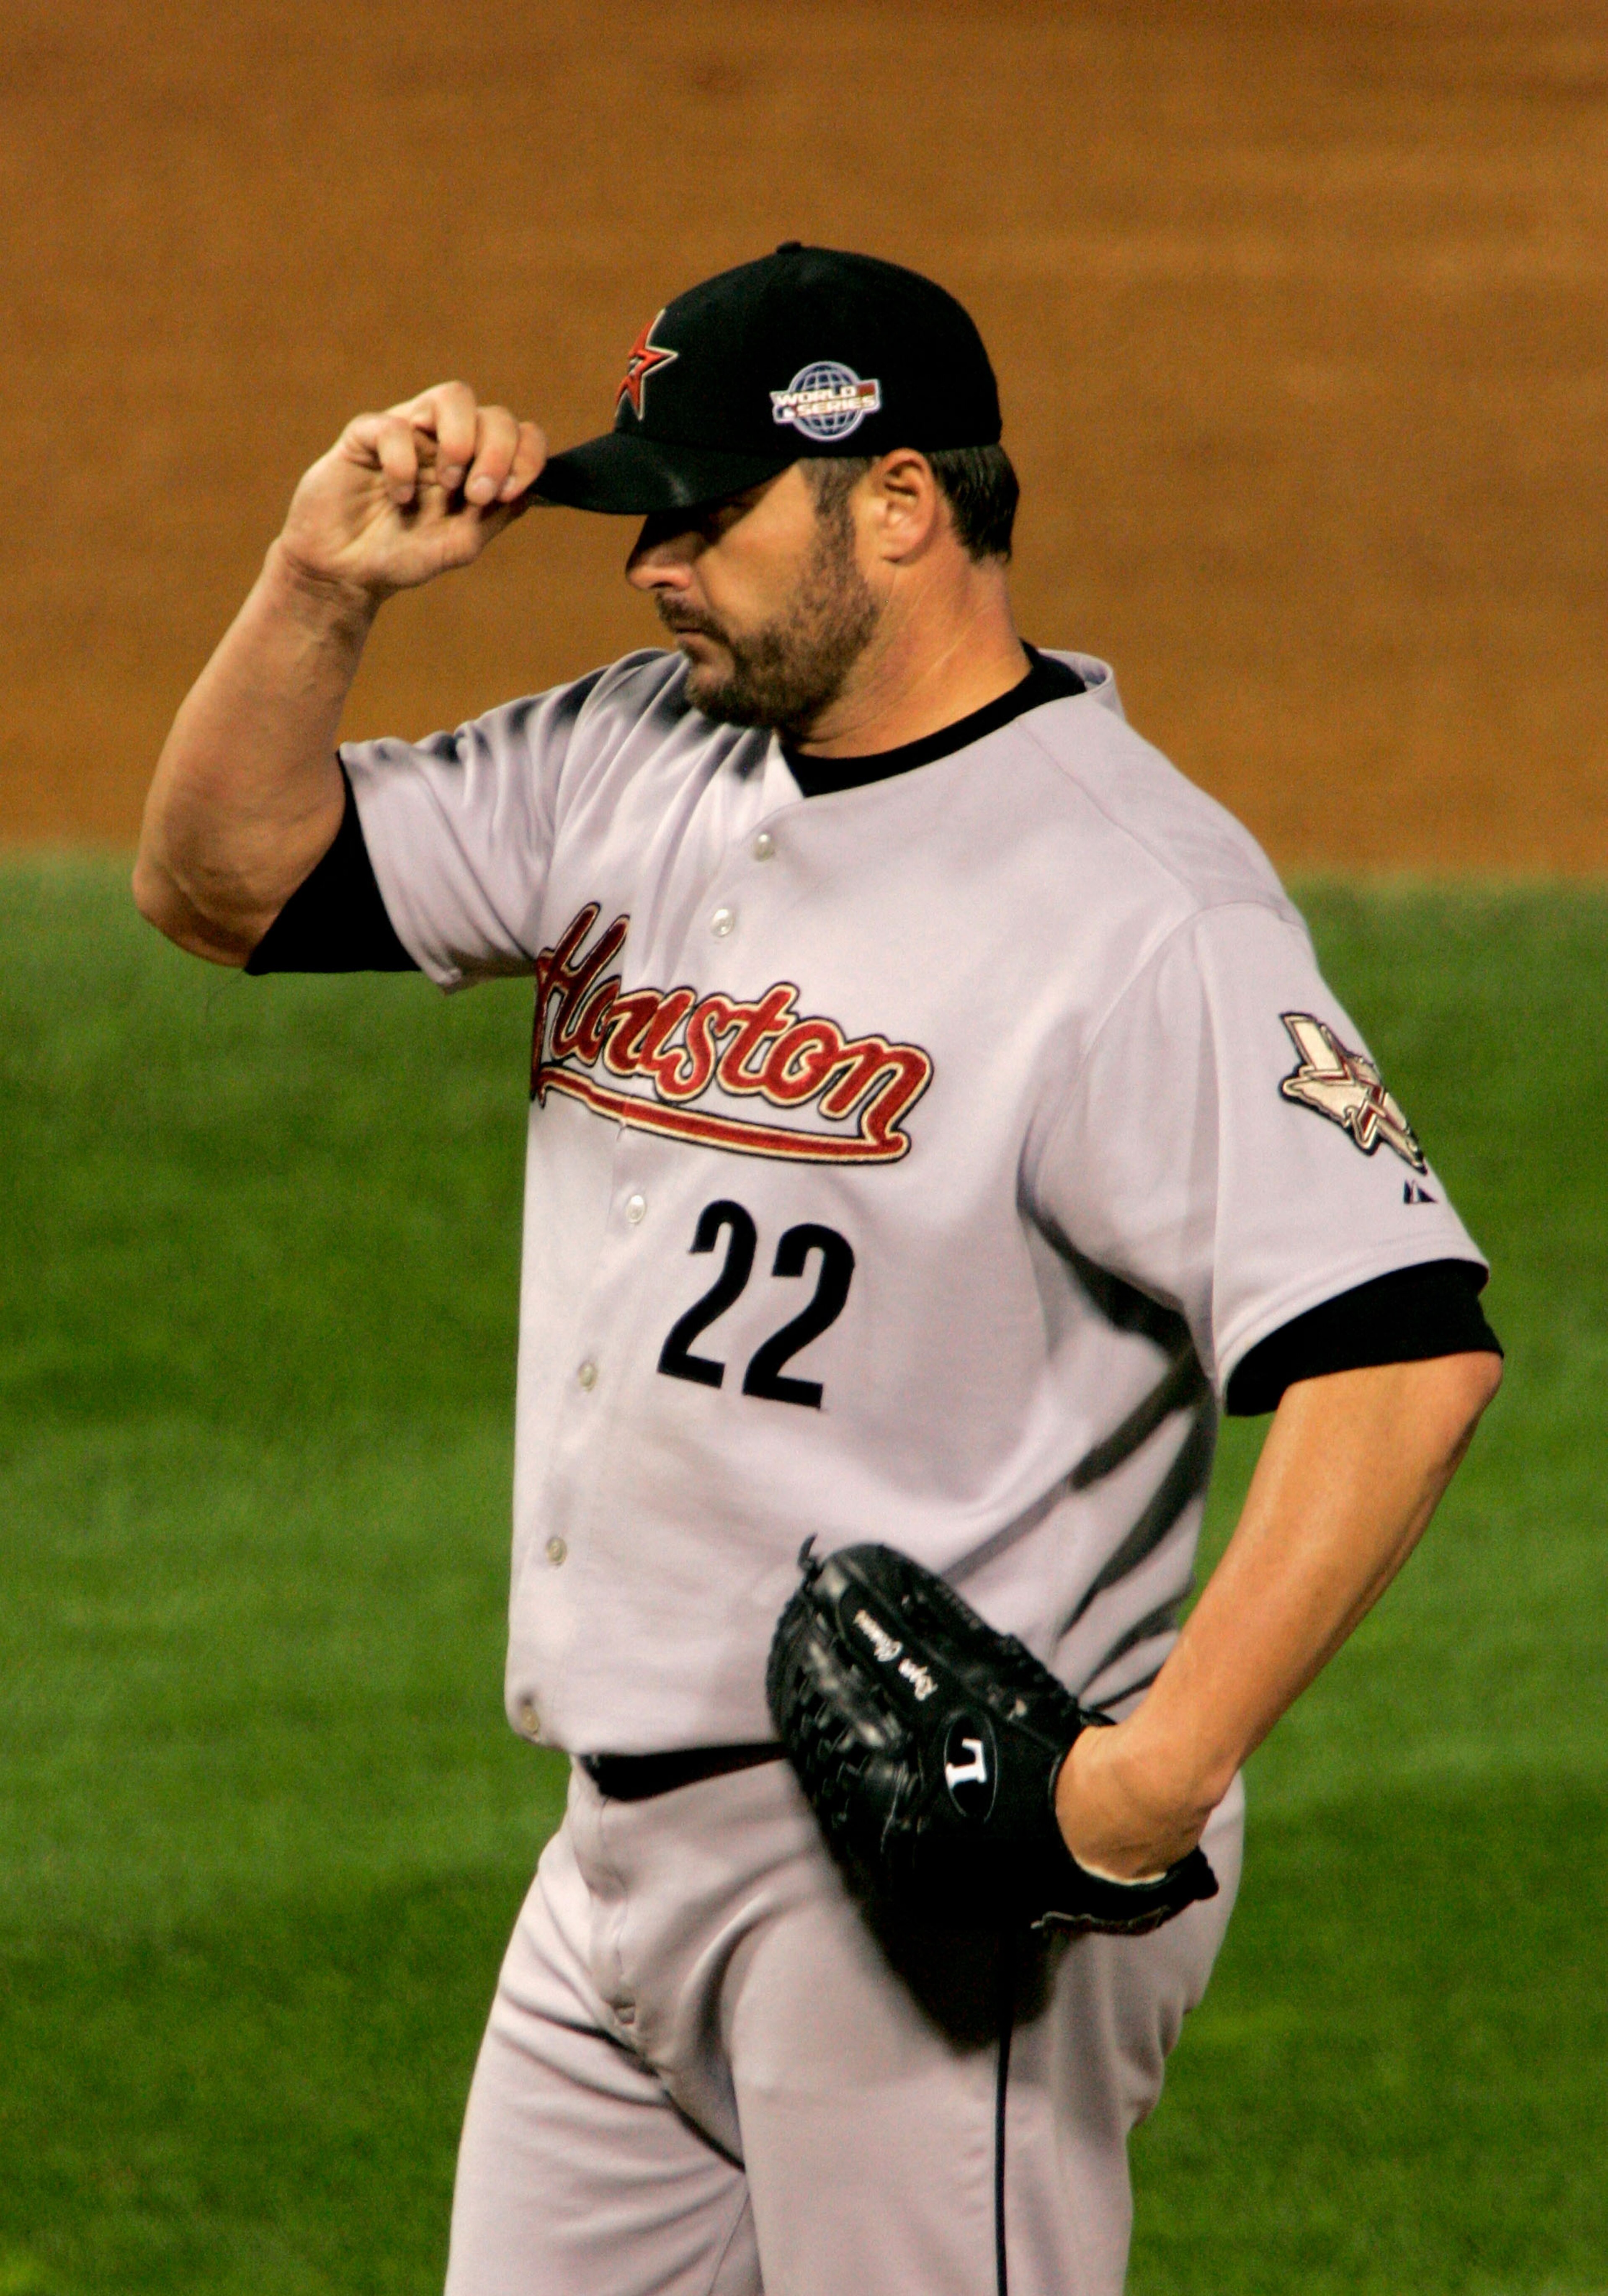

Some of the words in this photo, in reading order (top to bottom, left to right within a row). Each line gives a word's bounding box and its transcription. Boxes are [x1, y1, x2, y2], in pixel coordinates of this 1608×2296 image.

[776, 386, 857, 407] WORLD
[797, 395, 876, 418] SERIES
[531, 901, 934, 1166] Houston
[657, 1200, 855, 1409] 22
